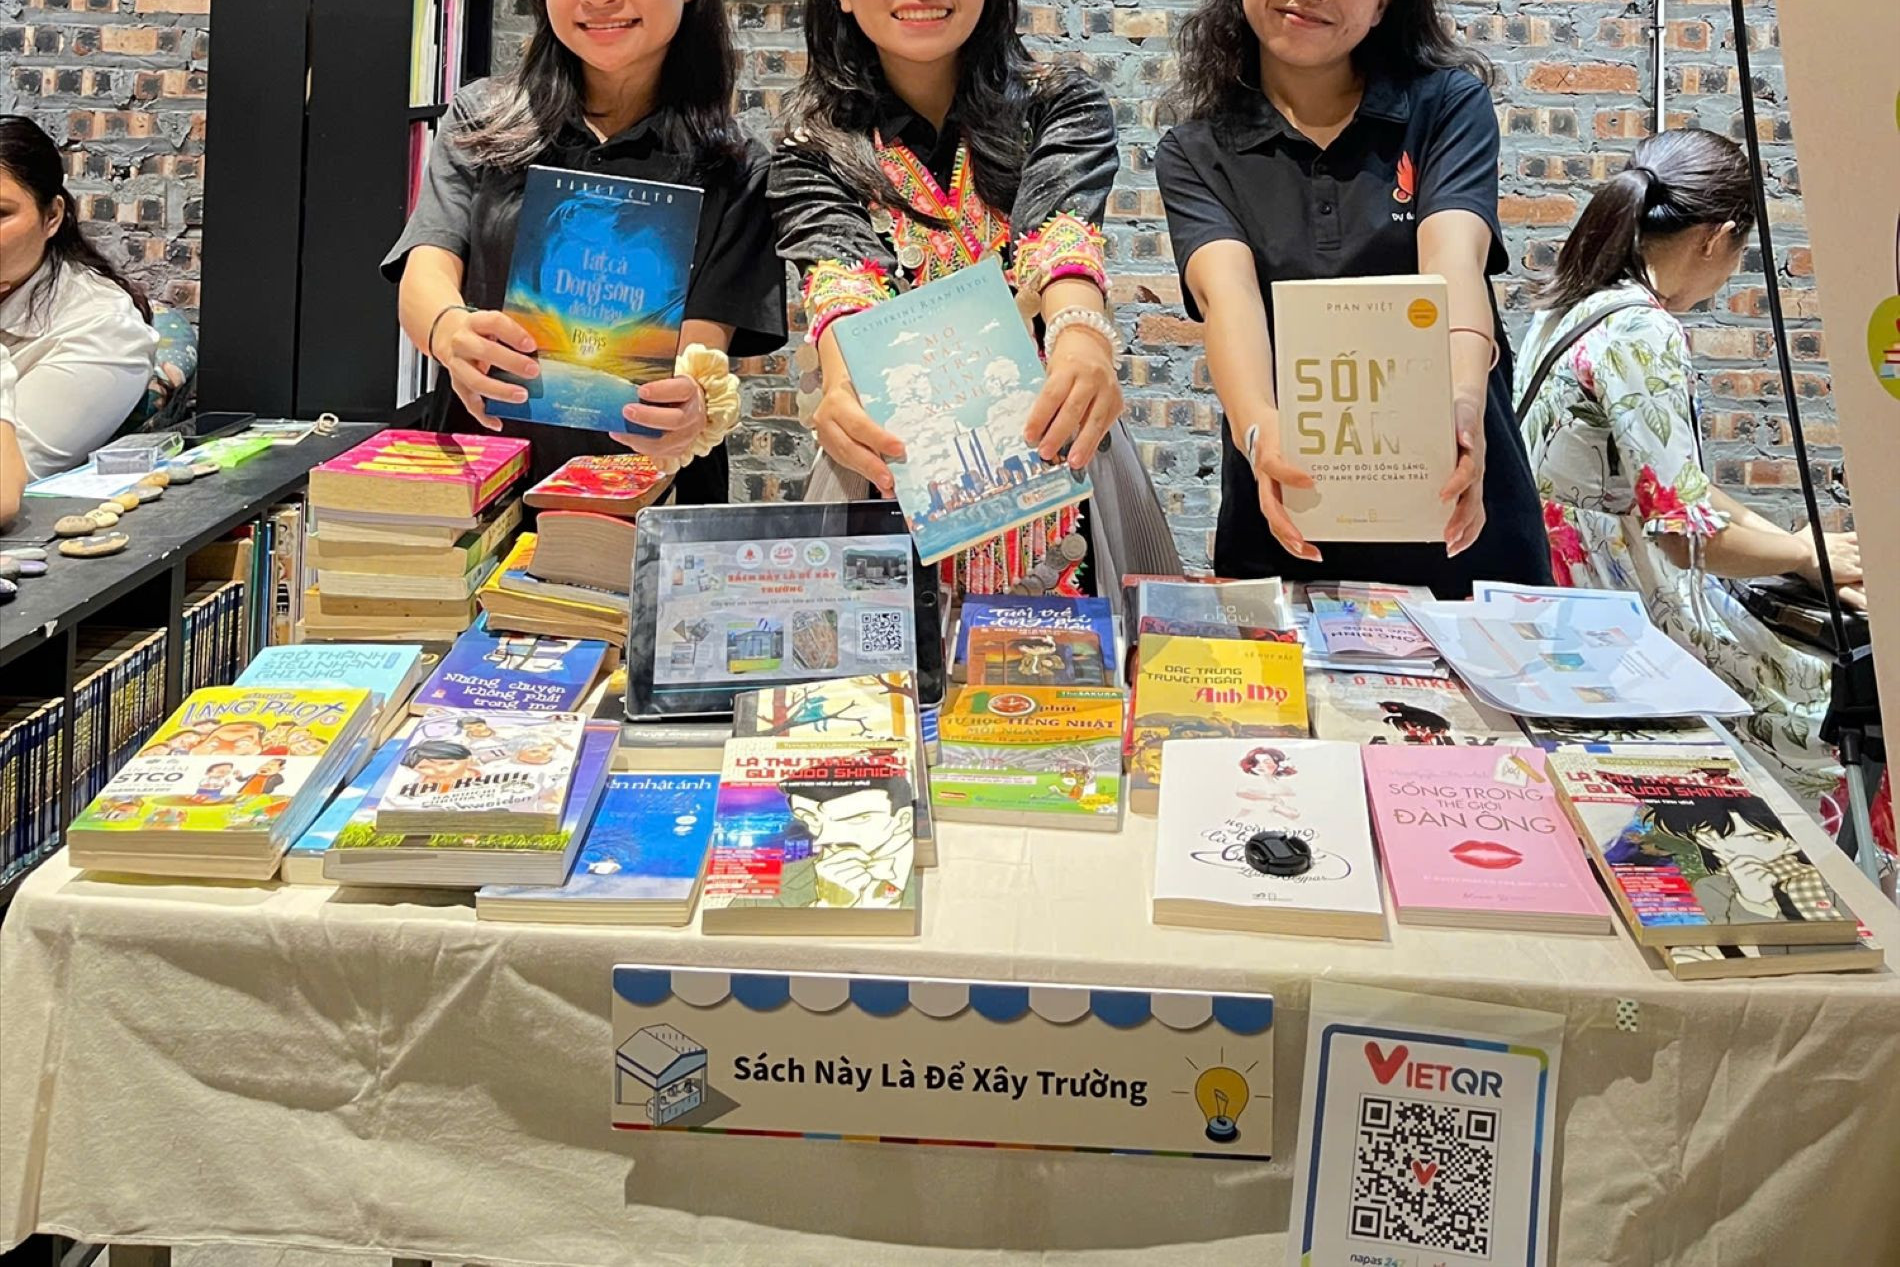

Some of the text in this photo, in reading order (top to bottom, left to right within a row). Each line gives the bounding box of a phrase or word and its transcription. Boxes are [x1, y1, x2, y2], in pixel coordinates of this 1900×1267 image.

[1461, 786, 1544, 802] TRONG
[1393, 806, 1557, 835] ĐÀN ÔNG
[733, 1051, 1149, 1108] Sách Này Là Để Xây Trường
[1364, 1040, 1503, 1098] VIETQR
[1350, 1252, 1383, 1266] napas
